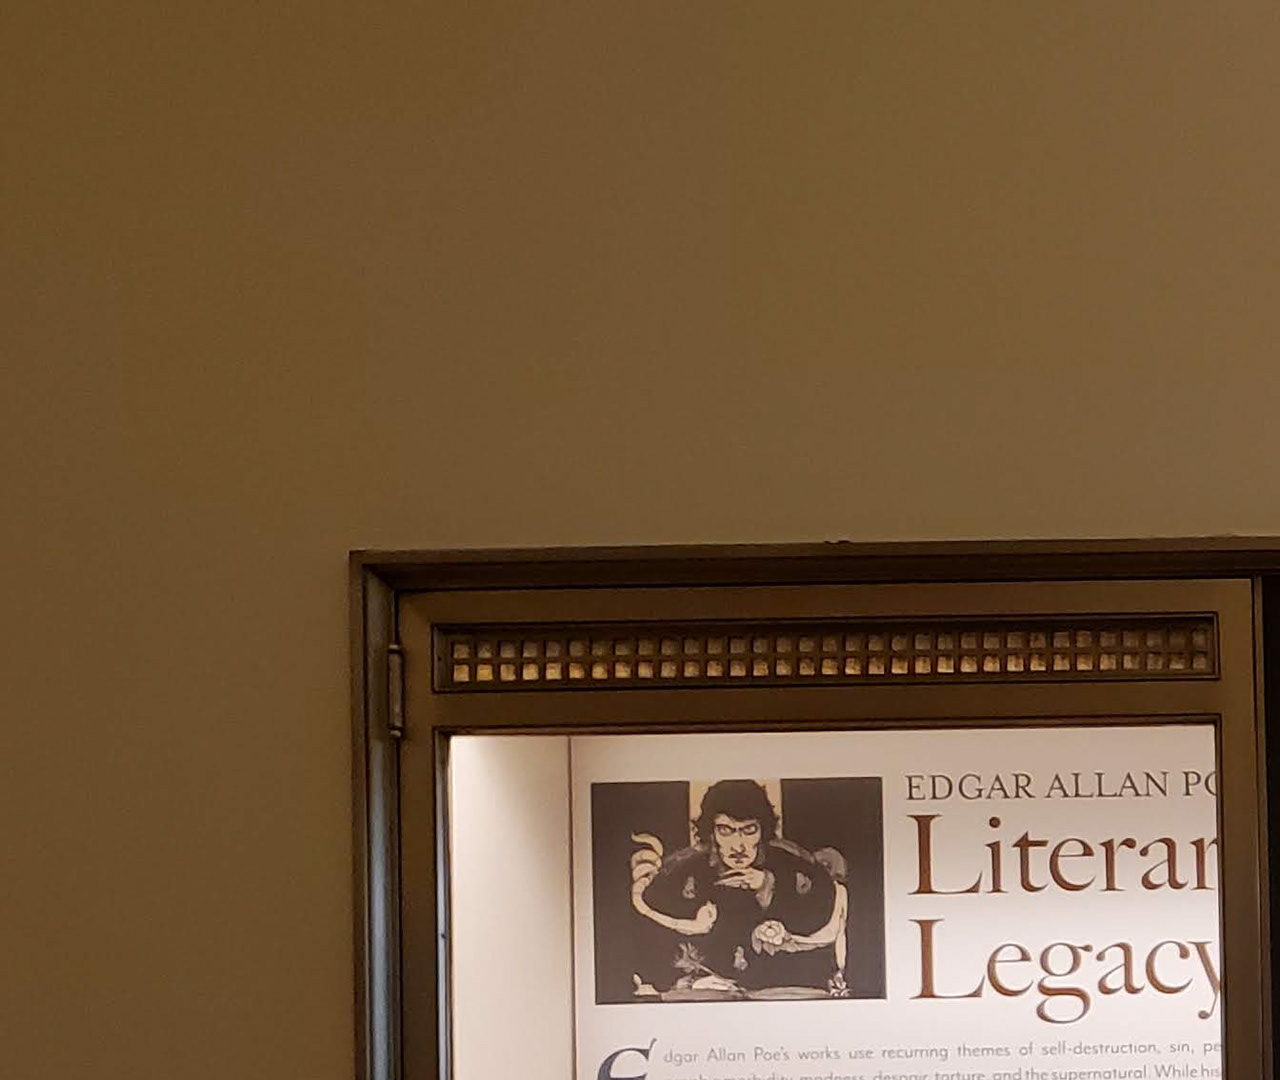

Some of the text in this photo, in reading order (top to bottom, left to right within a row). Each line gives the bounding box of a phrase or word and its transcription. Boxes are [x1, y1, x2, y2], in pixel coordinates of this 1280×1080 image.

[905, 773, 1035, 800] EDGAR
[1044, 771, 1170, 799] ALLAN
[906, 814, 1220, 895] Literar
[908, 918, 1221, 1025] Legacy
[705, 1047, 747, 1062] Allan
[752, 1046, 791, 1061] Poe's
[795, 1045, 842, 1060] works
[847, 1050, 875, 1059] use
[880, 1044, 949, 1062] recurring
[955, 1043, 1012, 1057] themes
[1017, 1041, 1034, 1056] of
